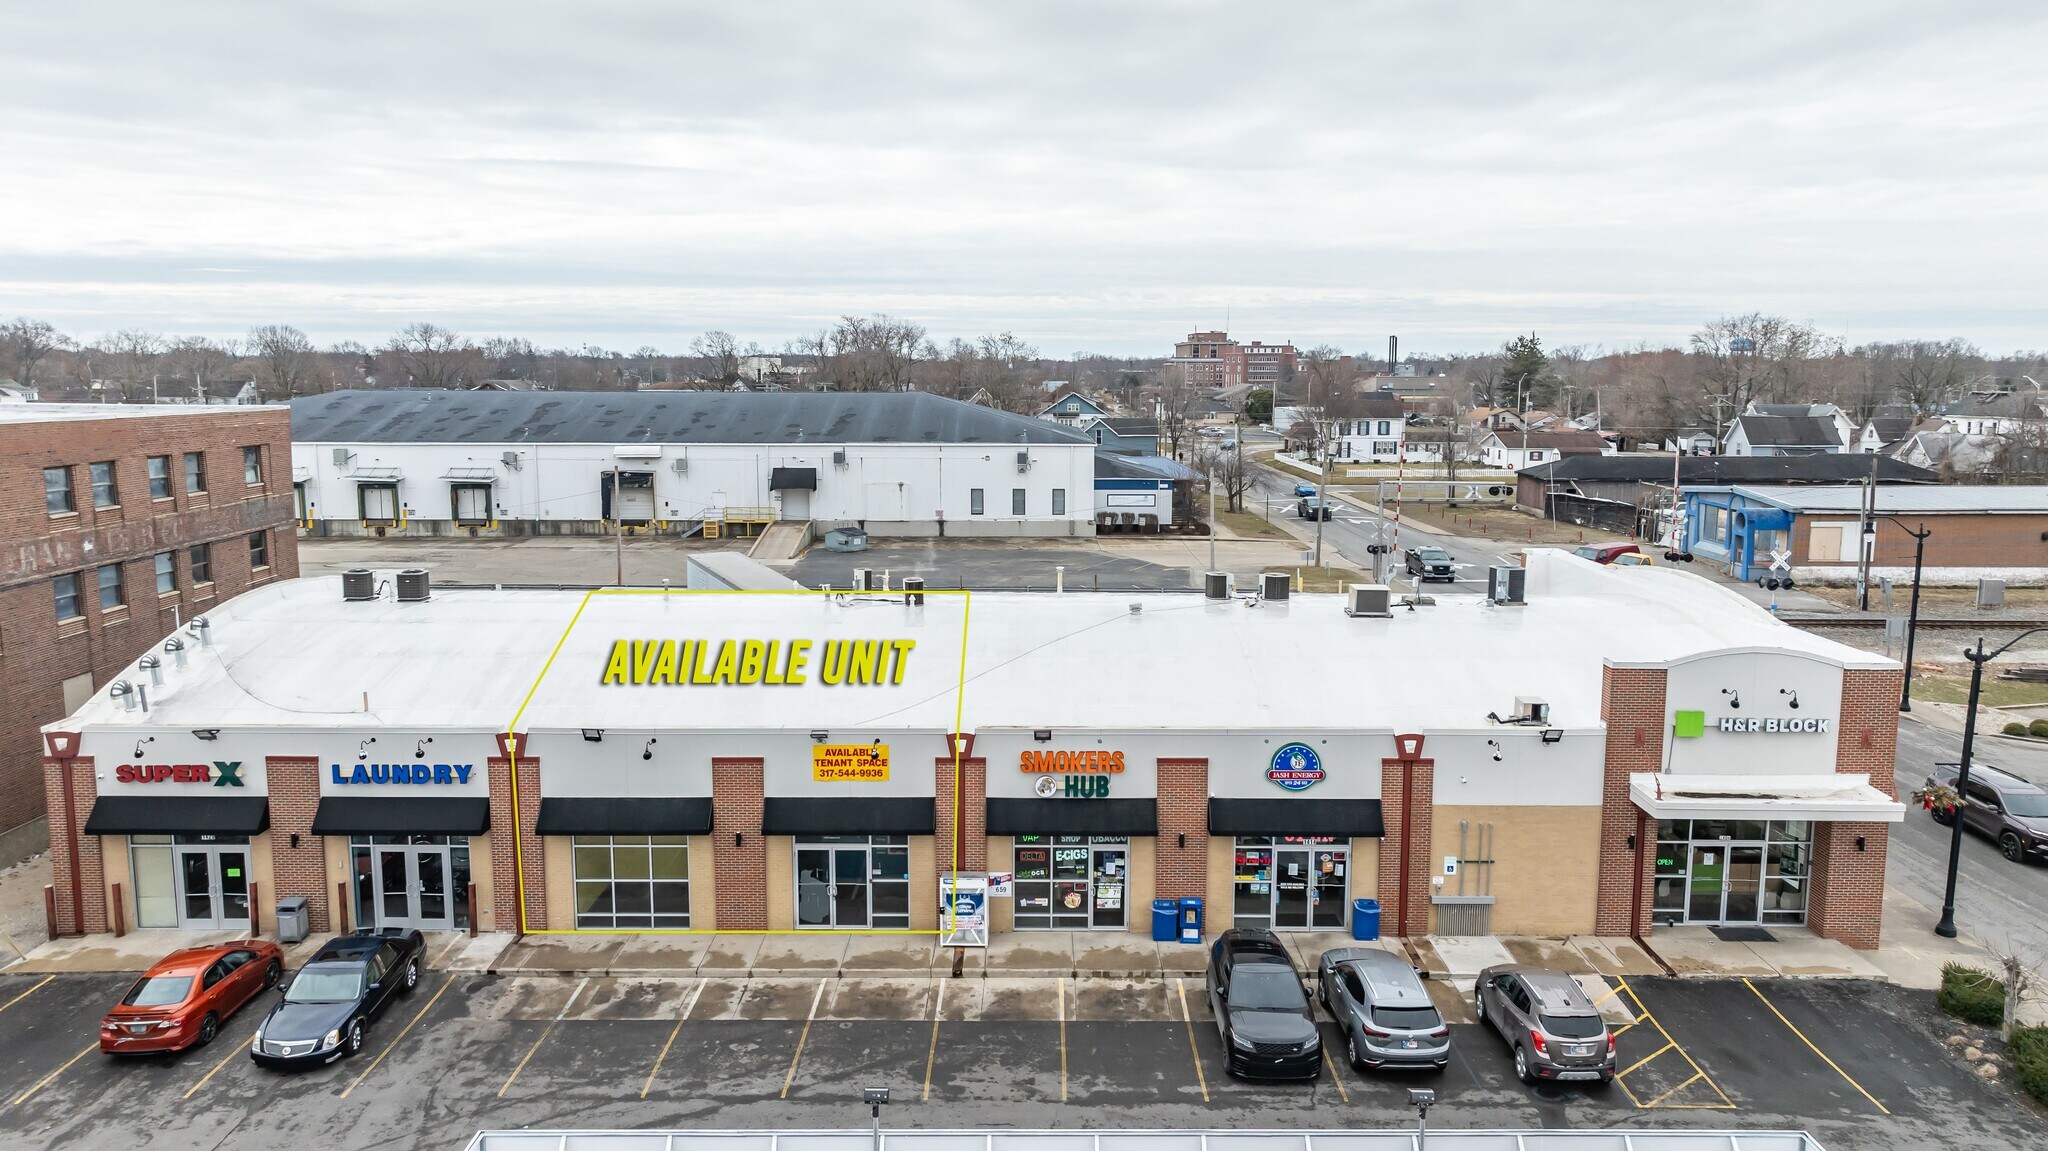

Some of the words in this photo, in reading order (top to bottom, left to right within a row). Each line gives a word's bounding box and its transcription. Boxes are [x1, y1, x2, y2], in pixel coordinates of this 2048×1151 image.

[1719, 717, 1760, 733] H&R
[1765, 718, 1830, 734] BLOCK
[825, 749, 878, 757] AVAILABL
[1020, 751, 1125, 774] SMOKERS
[815, 759, 853, 767] TENANT
[857, 759, 888, 767] SPACE
[116, 764, 211, 783] SUPER
[213, 761, 245, 787] X
[332, 764, 473, 785] LAUNDRY
[819, 769, 883, 777] 317-544-9936
[1064, 775, 1110, 798] HUB
